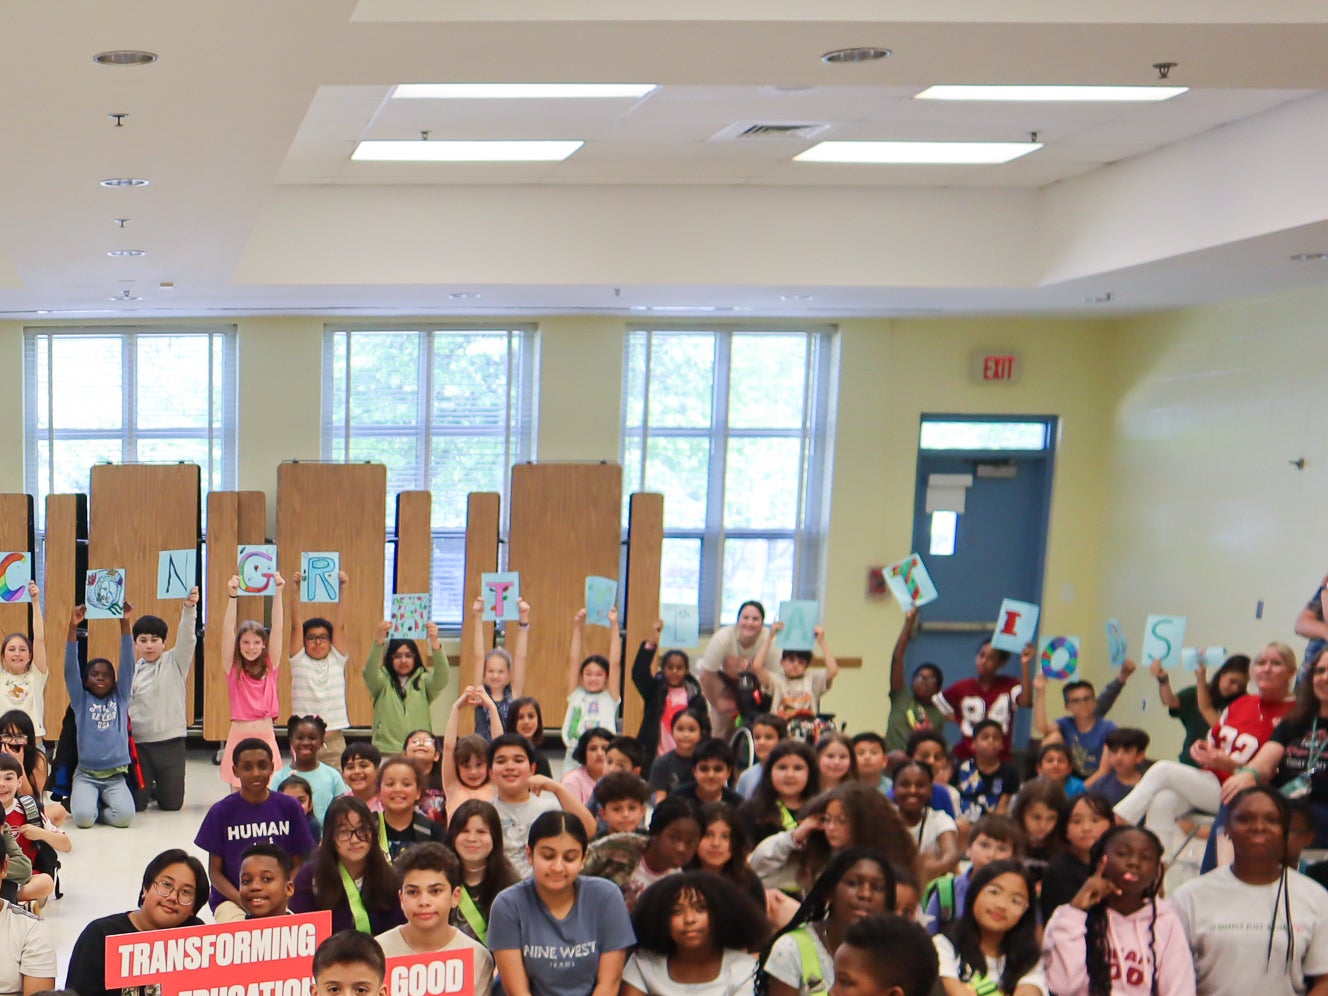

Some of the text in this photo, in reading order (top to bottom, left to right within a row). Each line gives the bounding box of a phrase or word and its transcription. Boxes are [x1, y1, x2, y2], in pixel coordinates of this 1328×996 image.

[983, 355, 1015, 380] EXIT
[165, 551, 189, 594] N
[239, 550, 274, 593] G
[307, 556, 337, 601] R
[486, 581, 515, 618] T
[786, 605, 808, 643] A
[1000, 610, 1022, 636] I
[1148, 618, 1174, 661] S
[1041, 636, 1079, 681] O
[227, 820, 290, 841] HUMAN
[118, 923, 317, 978] TRANSFORMING
[523, 940, 597, 960] NINE WEST
